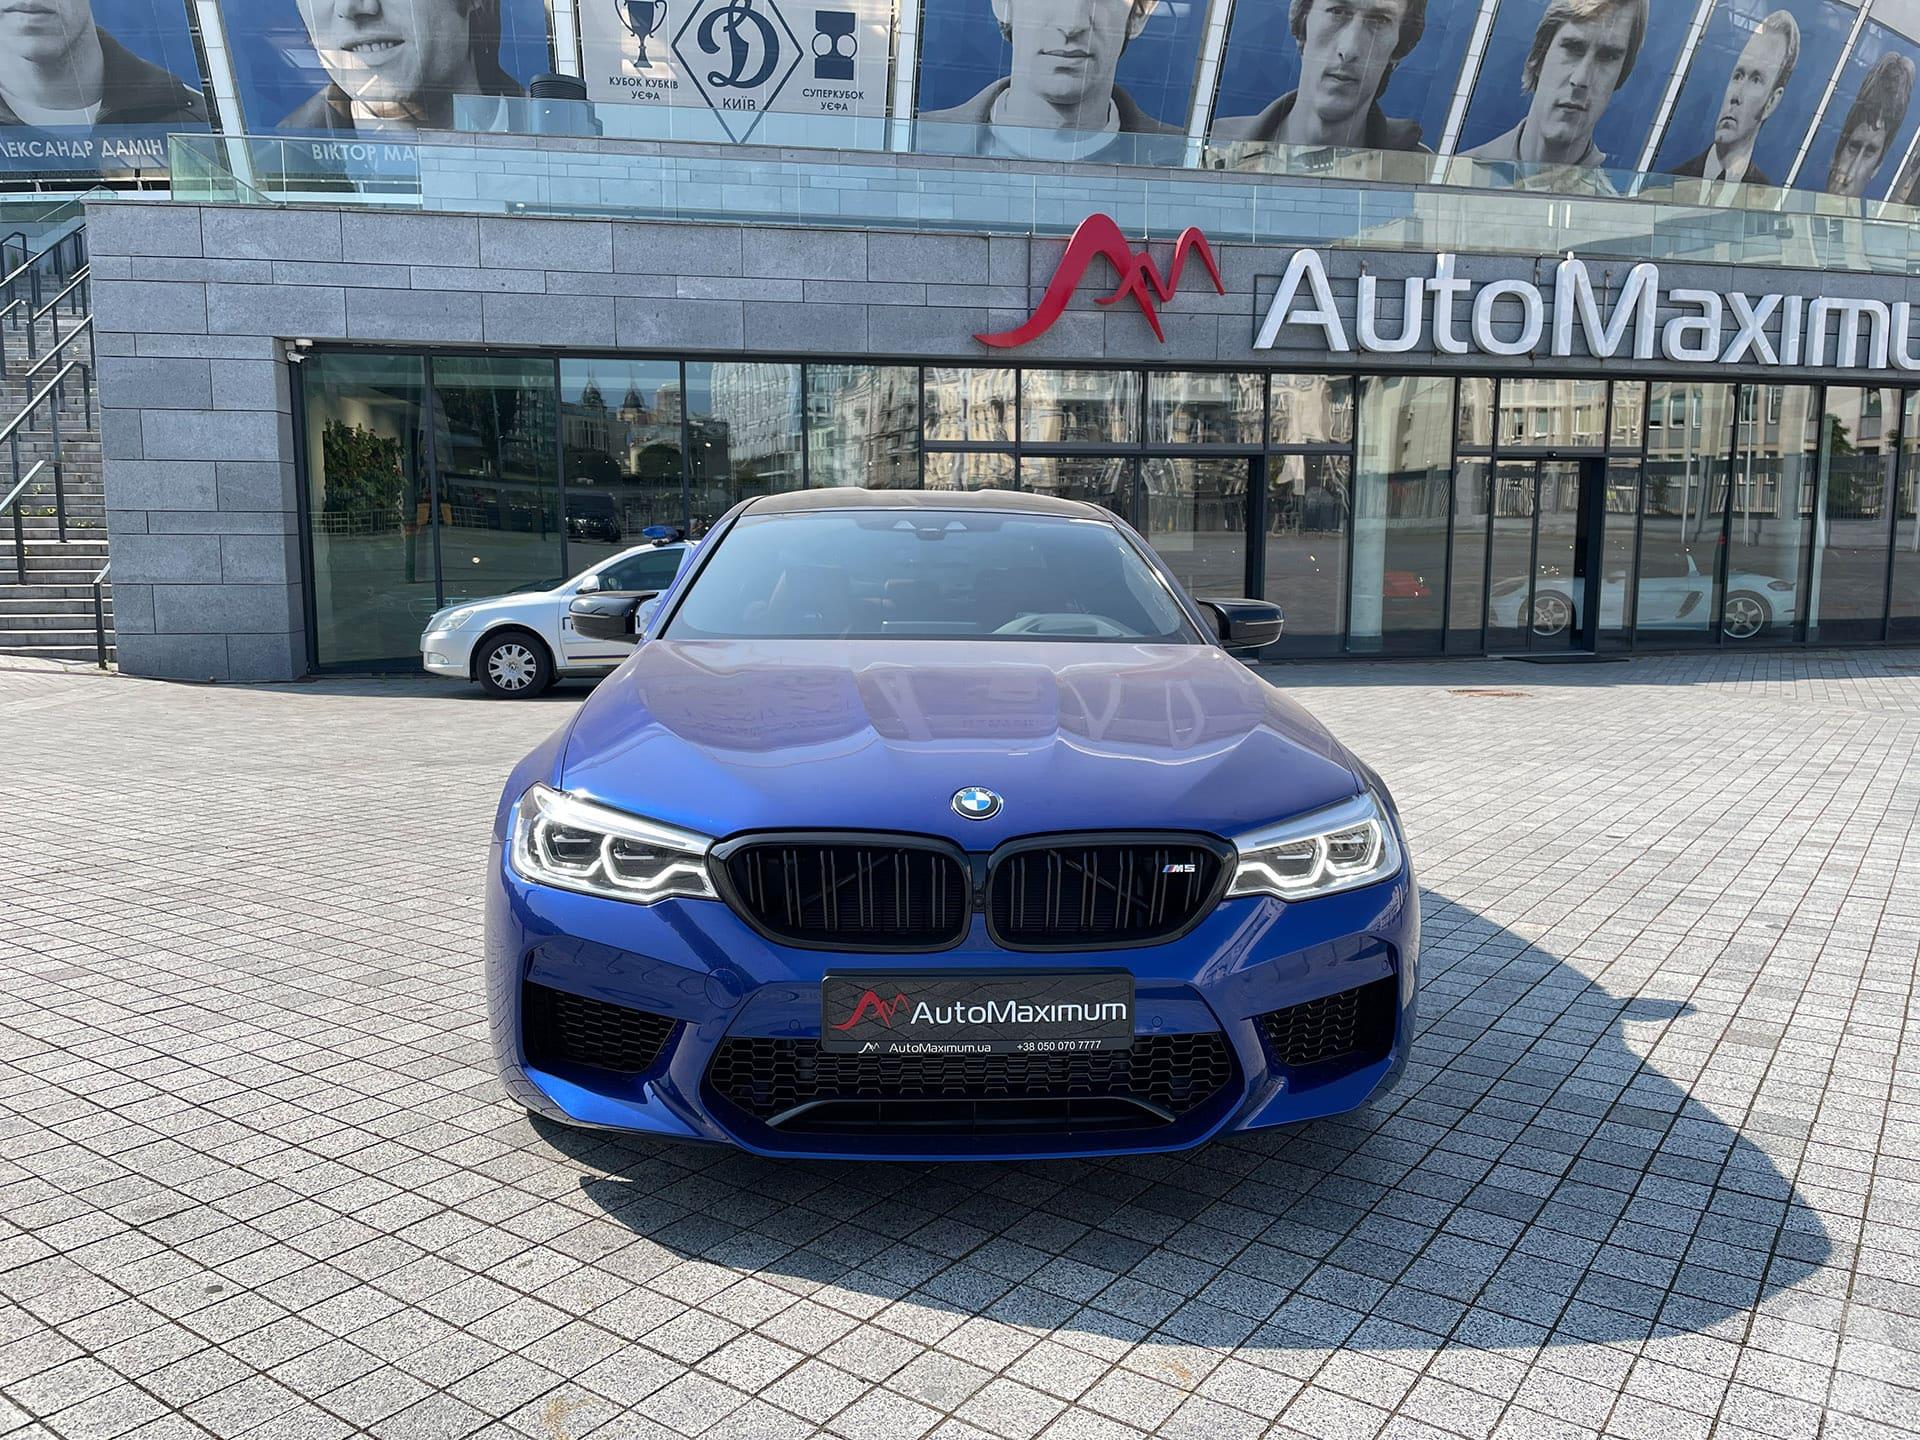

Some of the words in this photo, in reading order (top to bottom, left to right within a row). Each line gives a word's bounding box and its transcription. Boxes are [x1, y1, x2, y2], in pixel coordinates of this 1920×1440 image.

[609, 76, 642, 87] КУБОК
[645, 79, 679, 90] КУБКІВ
[631, 91, 660, 100] УЄФА
[802, 88, 864, 100] СУПЕРКУБОК
[723, 95, 756, 110] КИЇВ
[820, 102, 848, 111] УЄФА
[101, 139, 164, 158] ДАМІН
[311, 143, 377, 161] ВІКТОР
[1168, 864, 1196, 873] M5
[910, 1000, 1127, 1025] AutoMaximum
[889, 1042, 991, 1053] AutoMaximum.ua
[1016, 1042, 1035, 1051] +38
[1037, 1042, 1056, 1051] 050
[1058, 1041, 1076, 1051] 070
[1078, 1040, 1102, 1050] 7777
